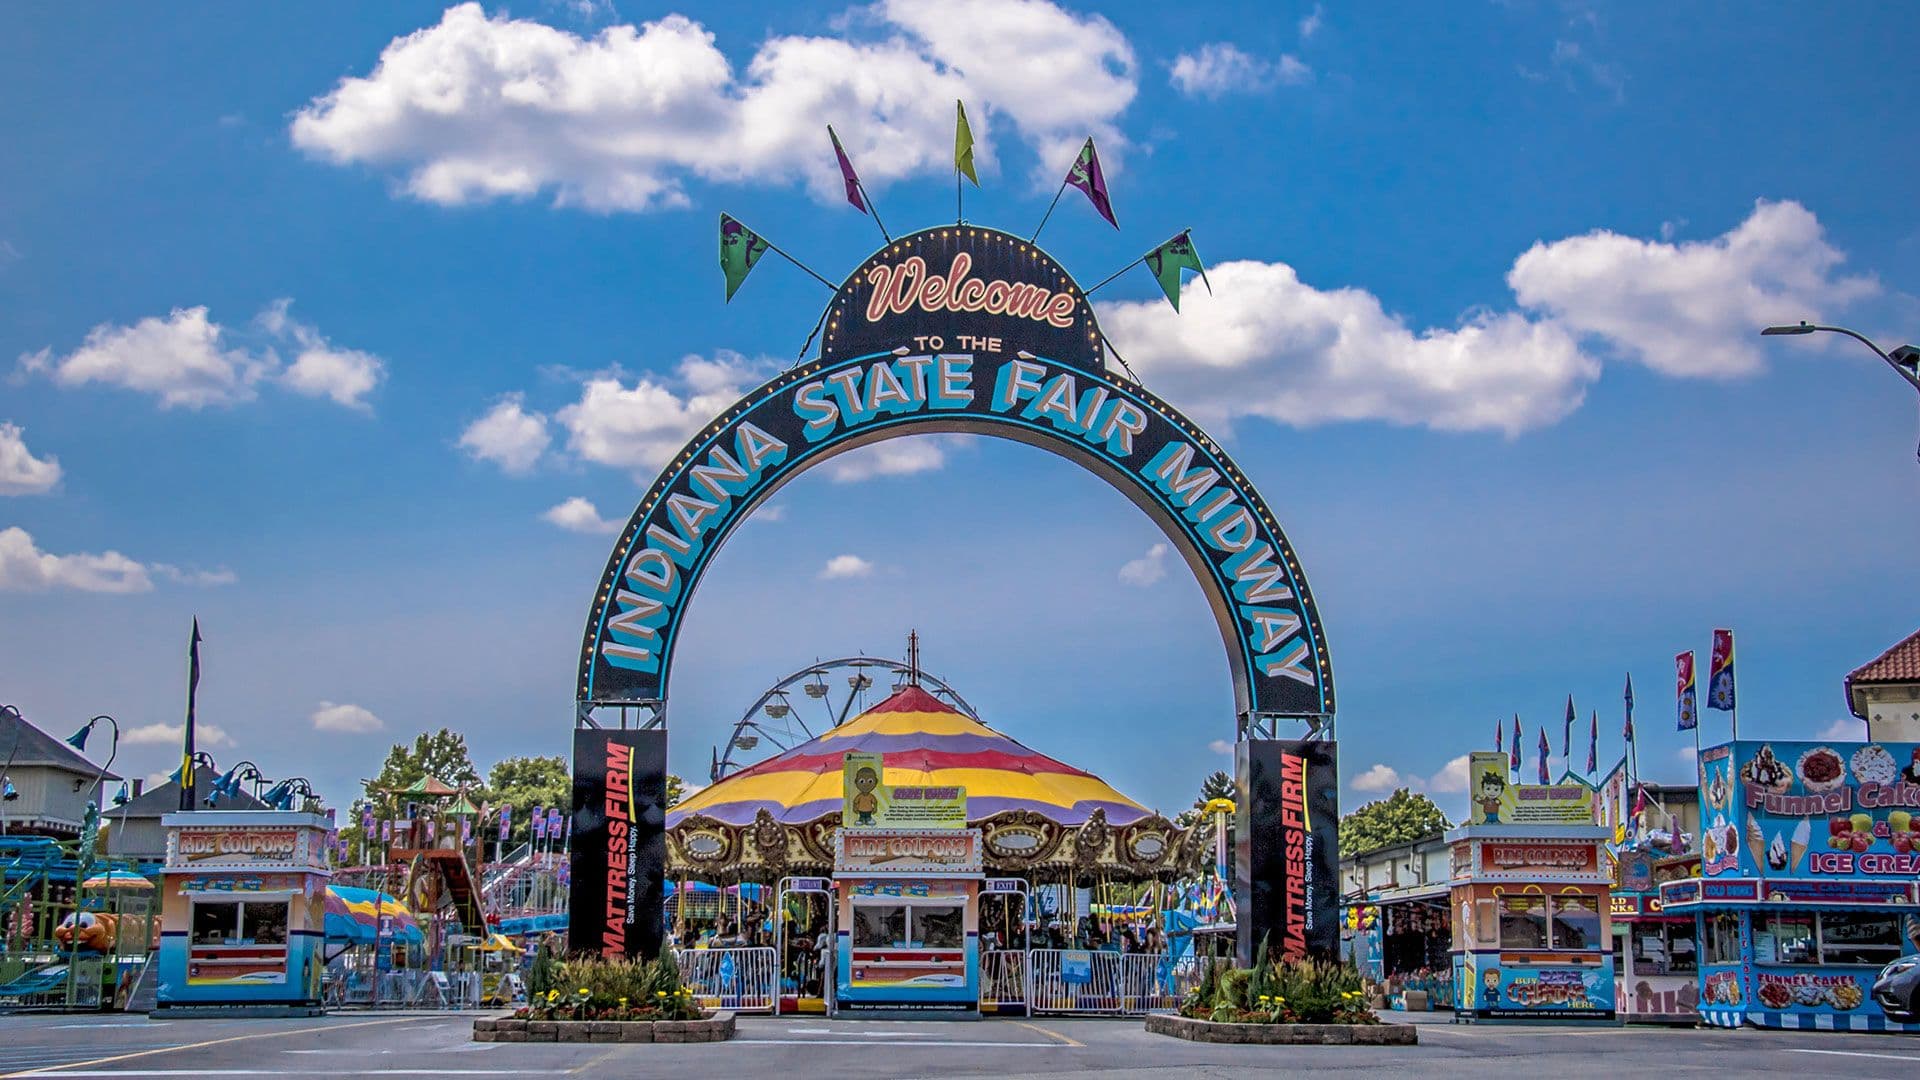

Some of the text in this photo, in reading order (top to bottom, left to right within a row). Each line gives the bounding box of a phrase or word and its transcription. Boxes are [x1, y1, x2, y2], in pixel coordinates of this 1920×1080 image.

[866, 252, 1075, 328] Welcome
[914, 335, 1002, 352] TO THE
[602, 354, 1316, 687] INDIANA STATE FAIR MIDWAY
[1746, 783, 1852, 815] Funnel
[179, 833, 296, 854] RIDE COUPONS
[850, 838, 967, 857] RIDE COUPONS
[627, 852, 638, 875] Sleep
[1493, 848, 1589, 866] RIDE COUPONS
[1810, 853, 1853, 873] ICE
[1305, 860, 1313, 882] Sleep
[996, 881, 1014, 890] EXIT
[626, 904, 635, 924] Save
[1305, 911, 1313, 930] Save
[1757, 974, 1855, 986] FUNNEL CAKES
[1507, 982, 1588, 1005] COUPONS
[1567, 1001, 1595, 1009] HERE
